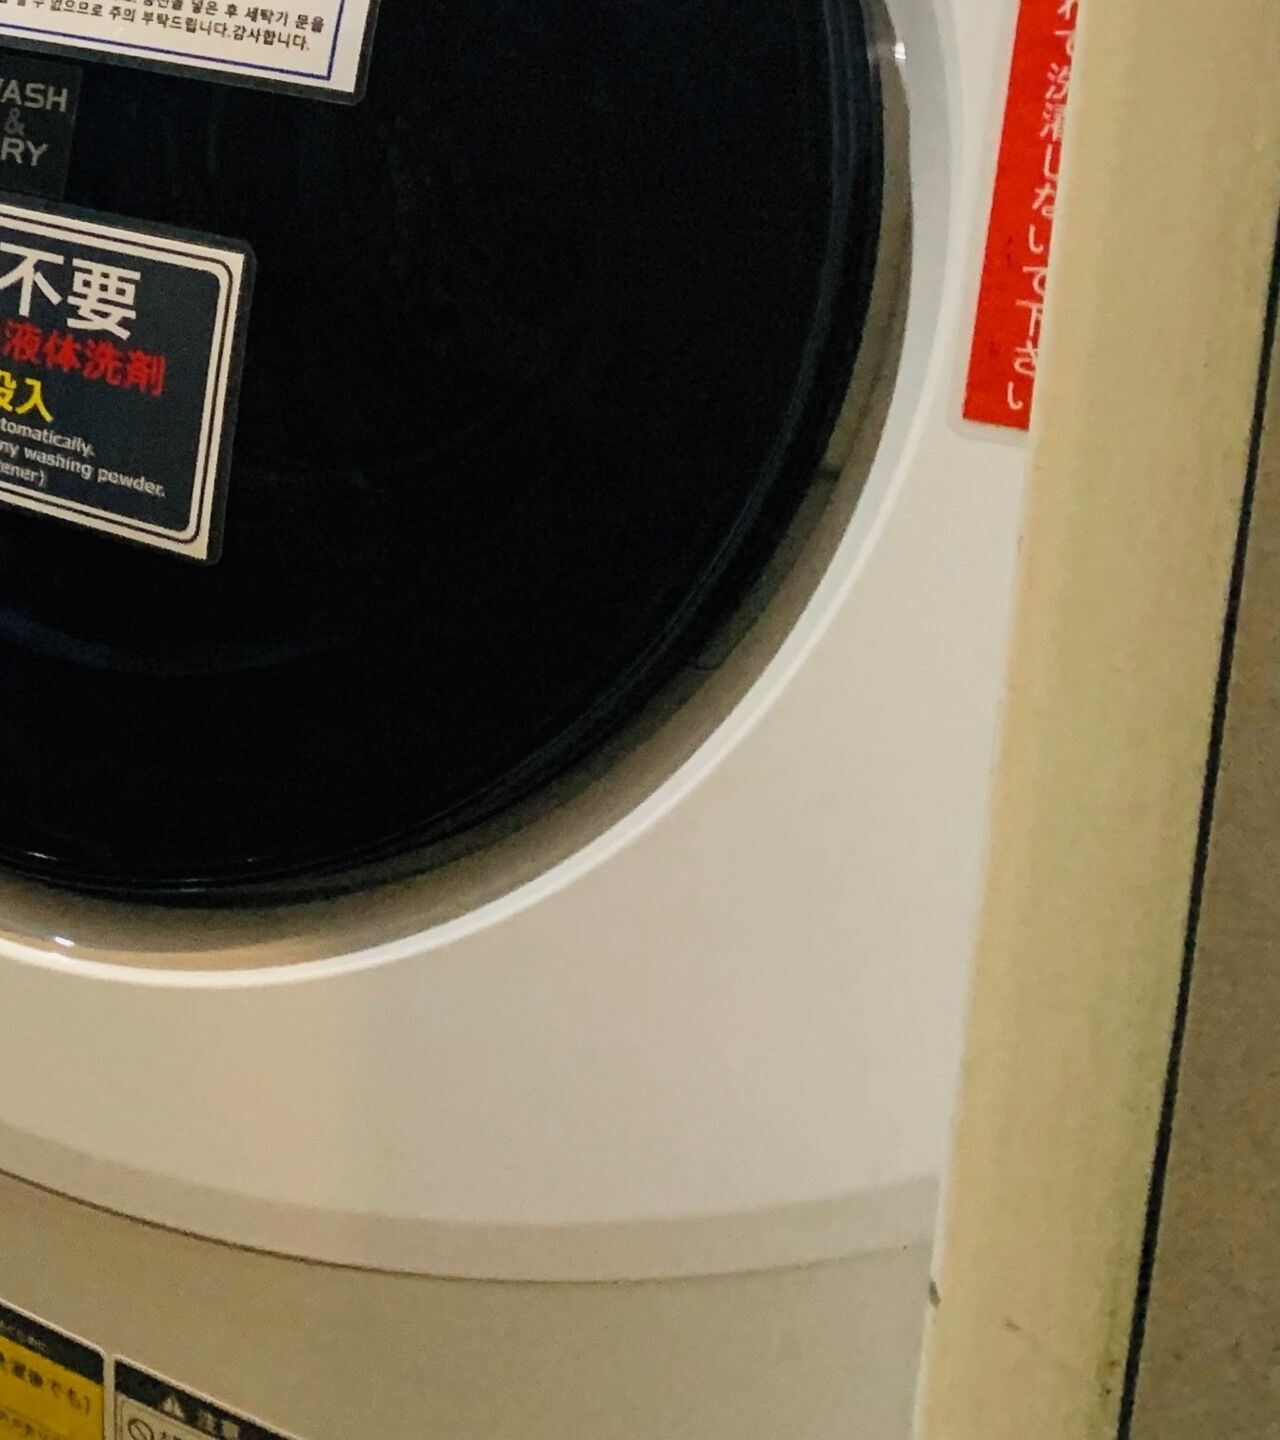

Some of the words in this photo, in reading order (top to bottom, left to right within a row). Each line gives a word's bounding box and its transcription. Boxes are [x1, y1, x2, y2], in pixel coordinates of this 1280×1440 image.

[2, 105, 32, 138] &
[24, 447, 94, 478] washing
[97, 468, 165, 497] powder.
